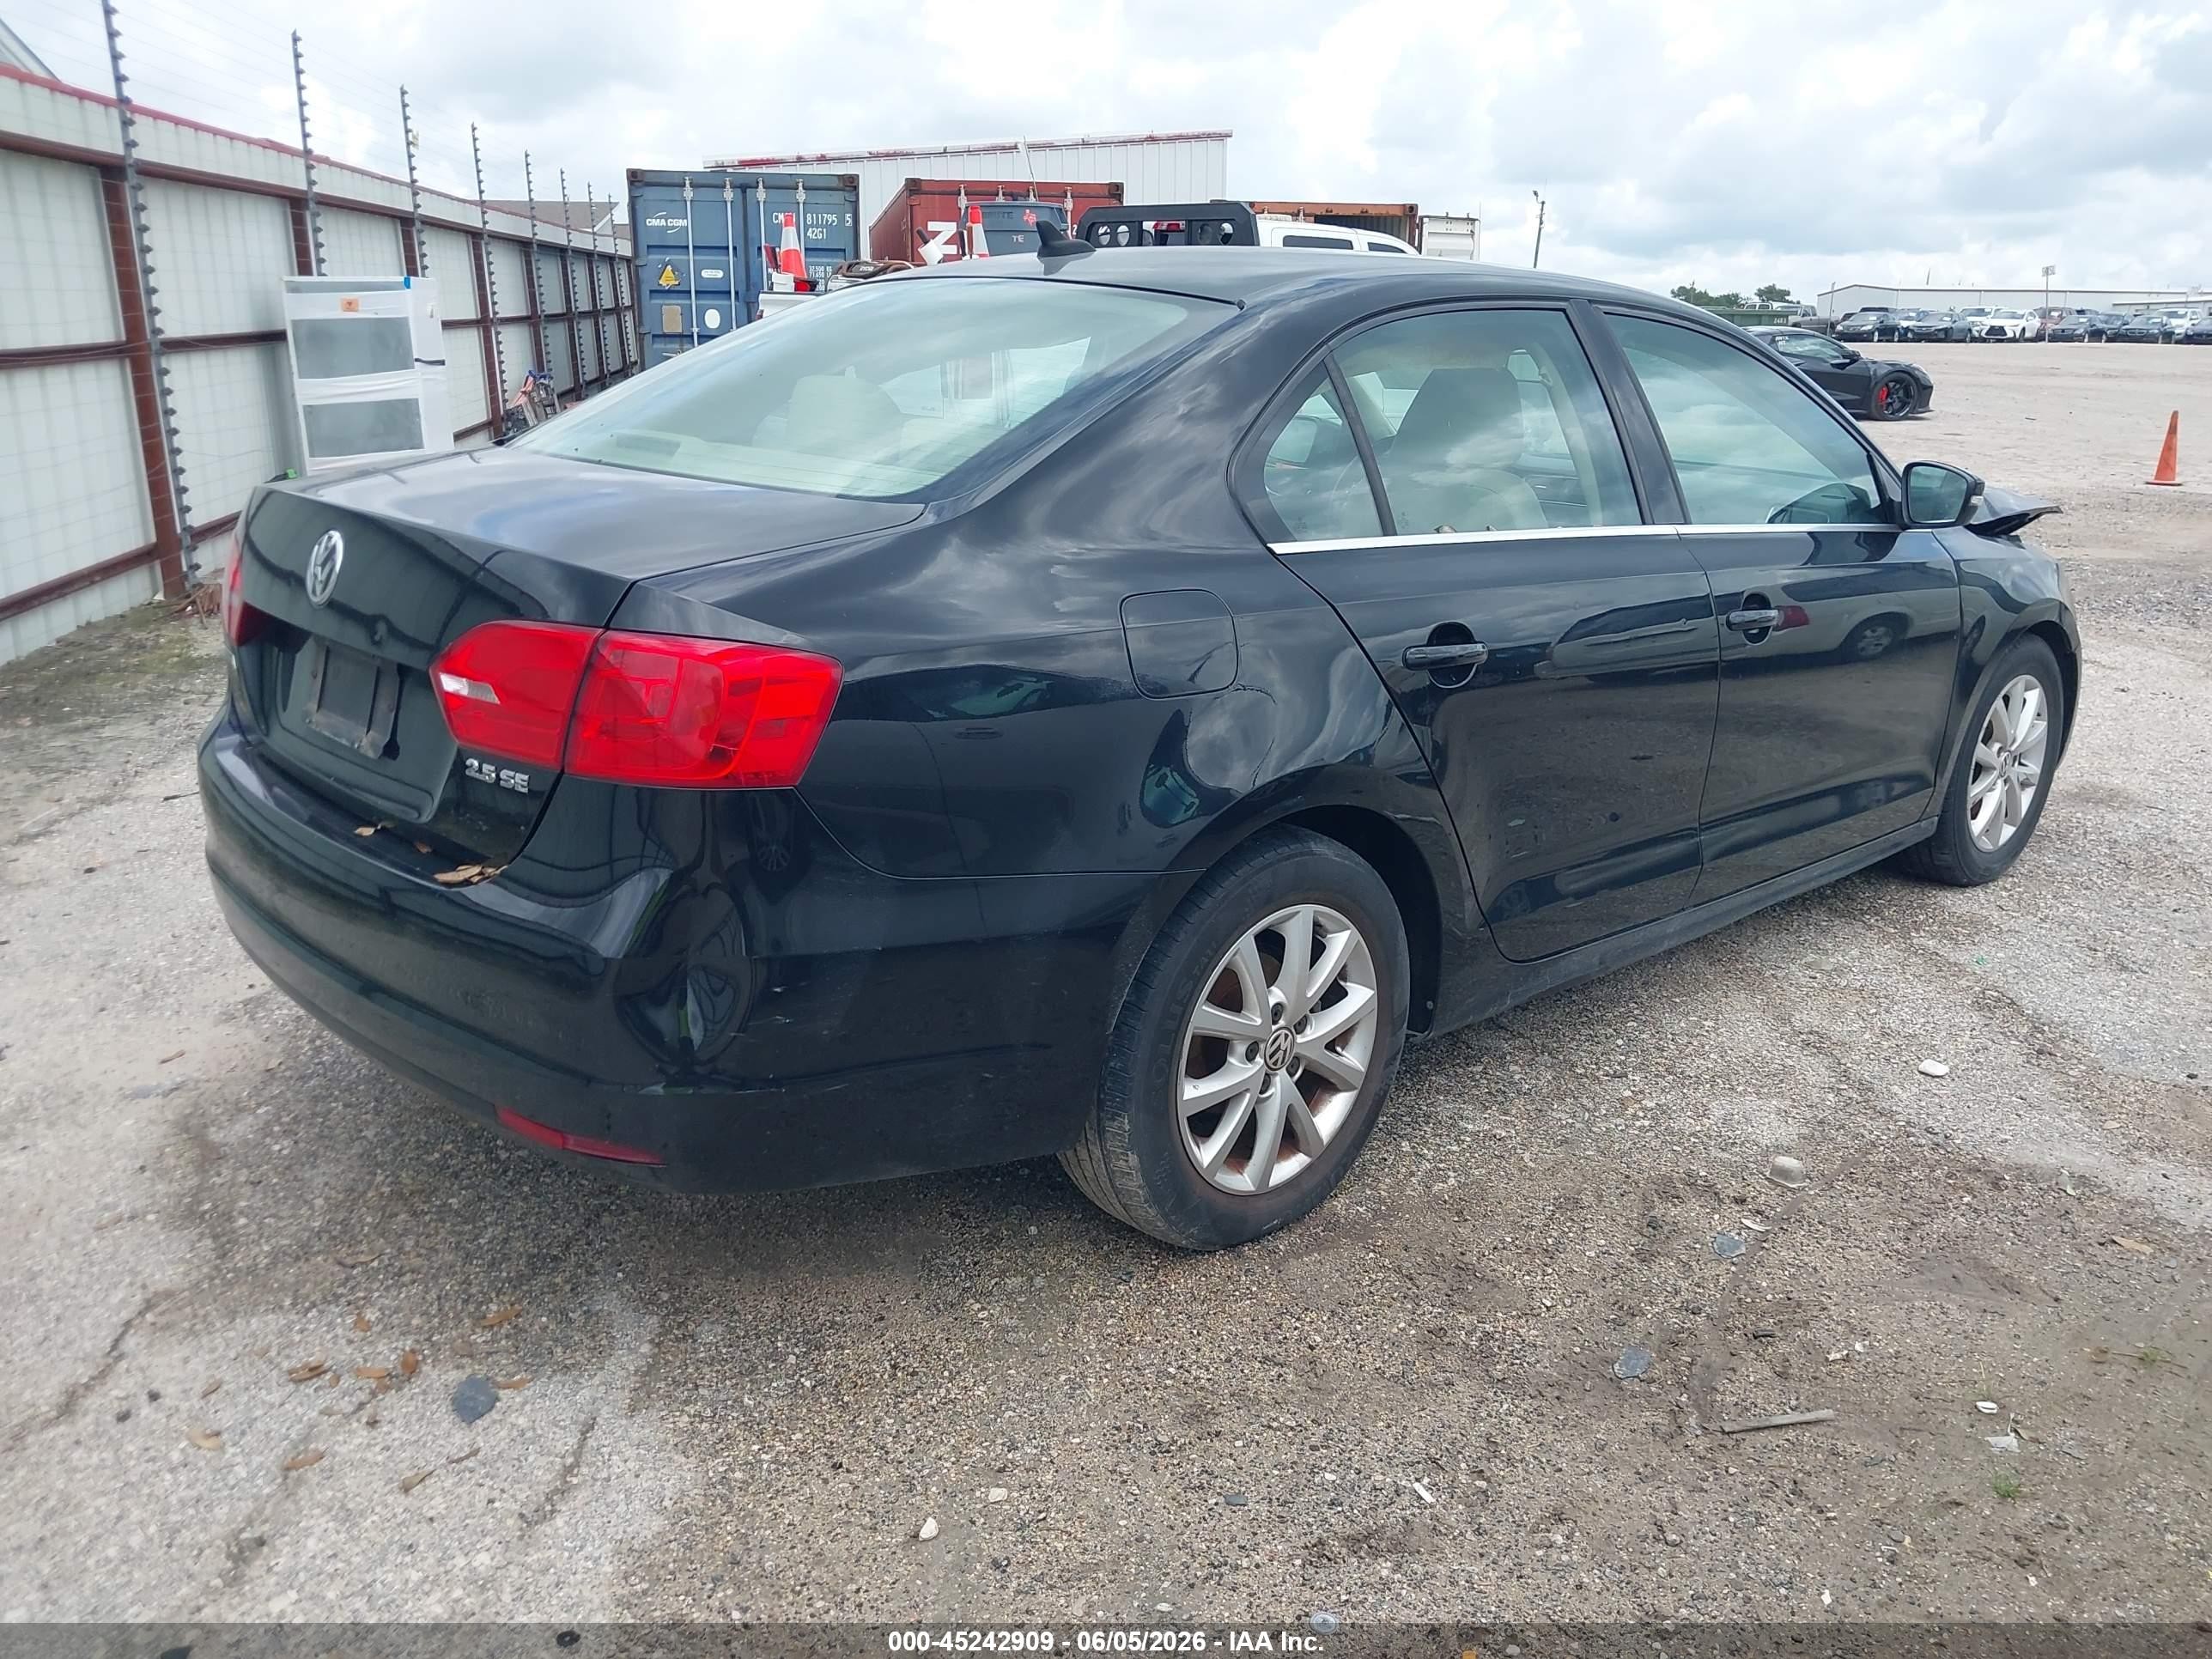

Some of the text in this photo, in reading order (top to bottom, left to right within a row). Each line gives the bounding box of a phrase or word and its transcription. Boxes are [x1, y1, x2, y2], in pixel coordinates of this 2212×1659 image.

[646, 218, 688, 227] CMA CGM
[806, 213, 838, 226] 811795
[806, 227, 827, 240] 42G1
[500, 769, 530, 793] SE
